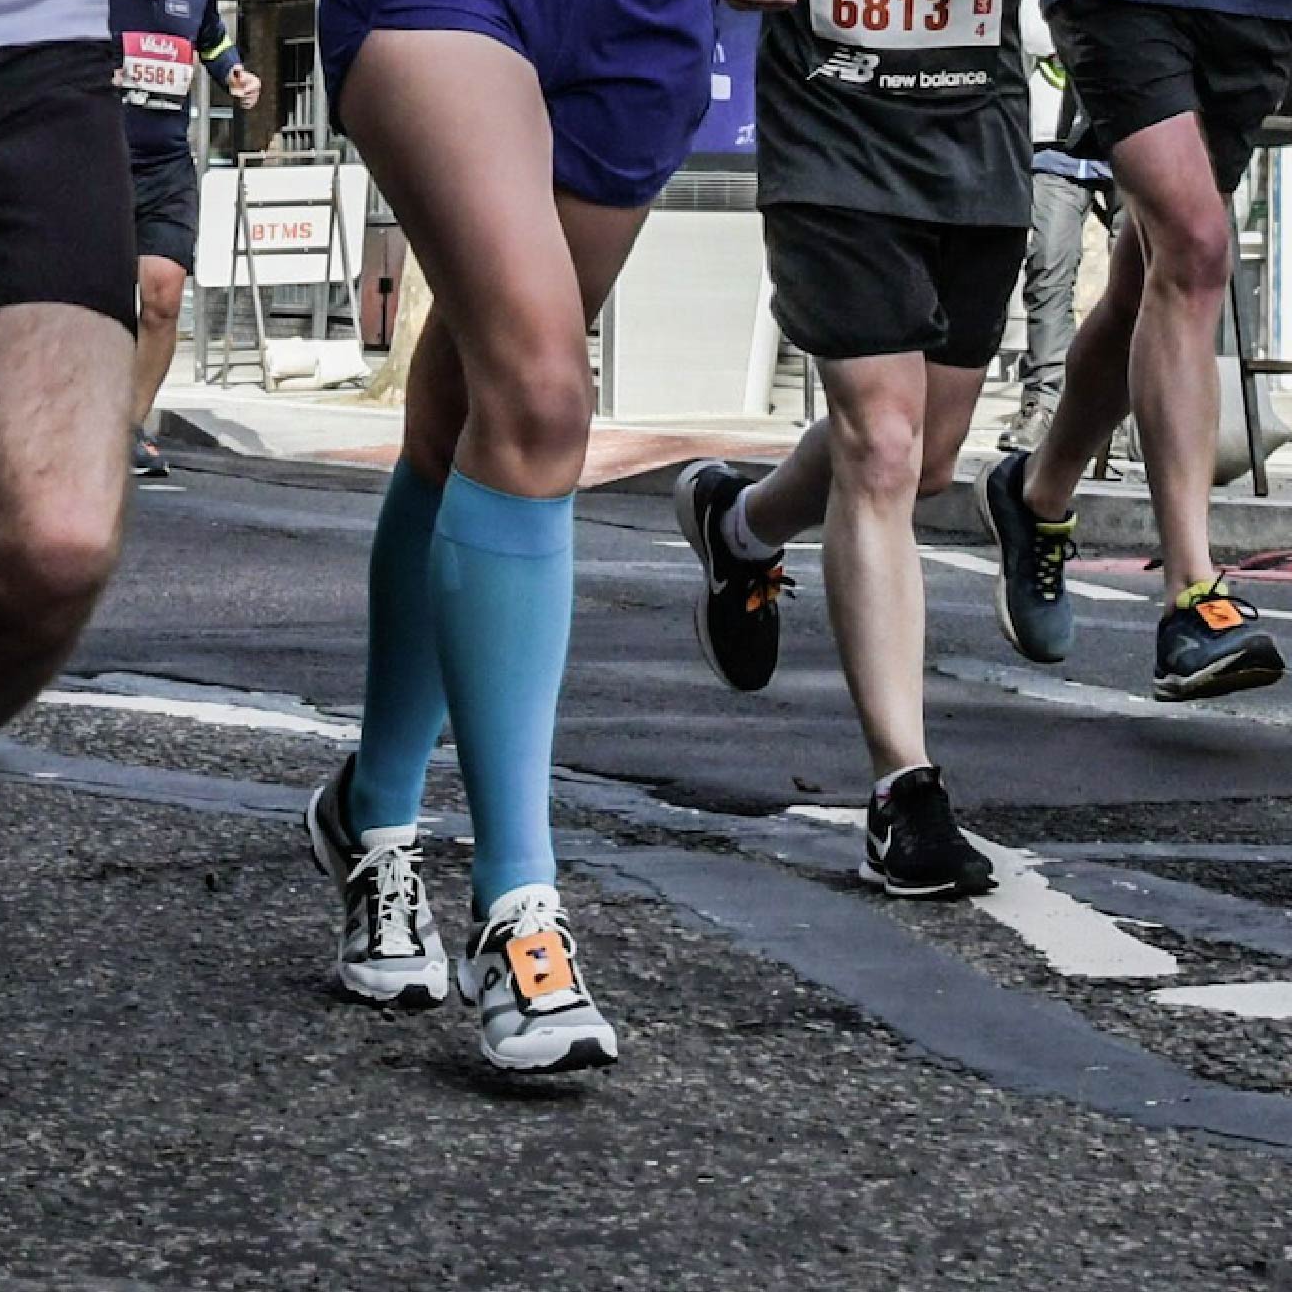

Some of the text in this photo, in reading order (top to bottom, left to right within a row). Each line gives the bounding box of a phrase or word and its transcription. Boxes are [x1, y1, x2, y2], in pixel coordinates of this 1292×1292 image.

[130, 64, 175, 85] 5584
[879, 73, 918, 89] new
[919, 69, 988, 88] balance
[251, 222, 313, 241] BTMS
